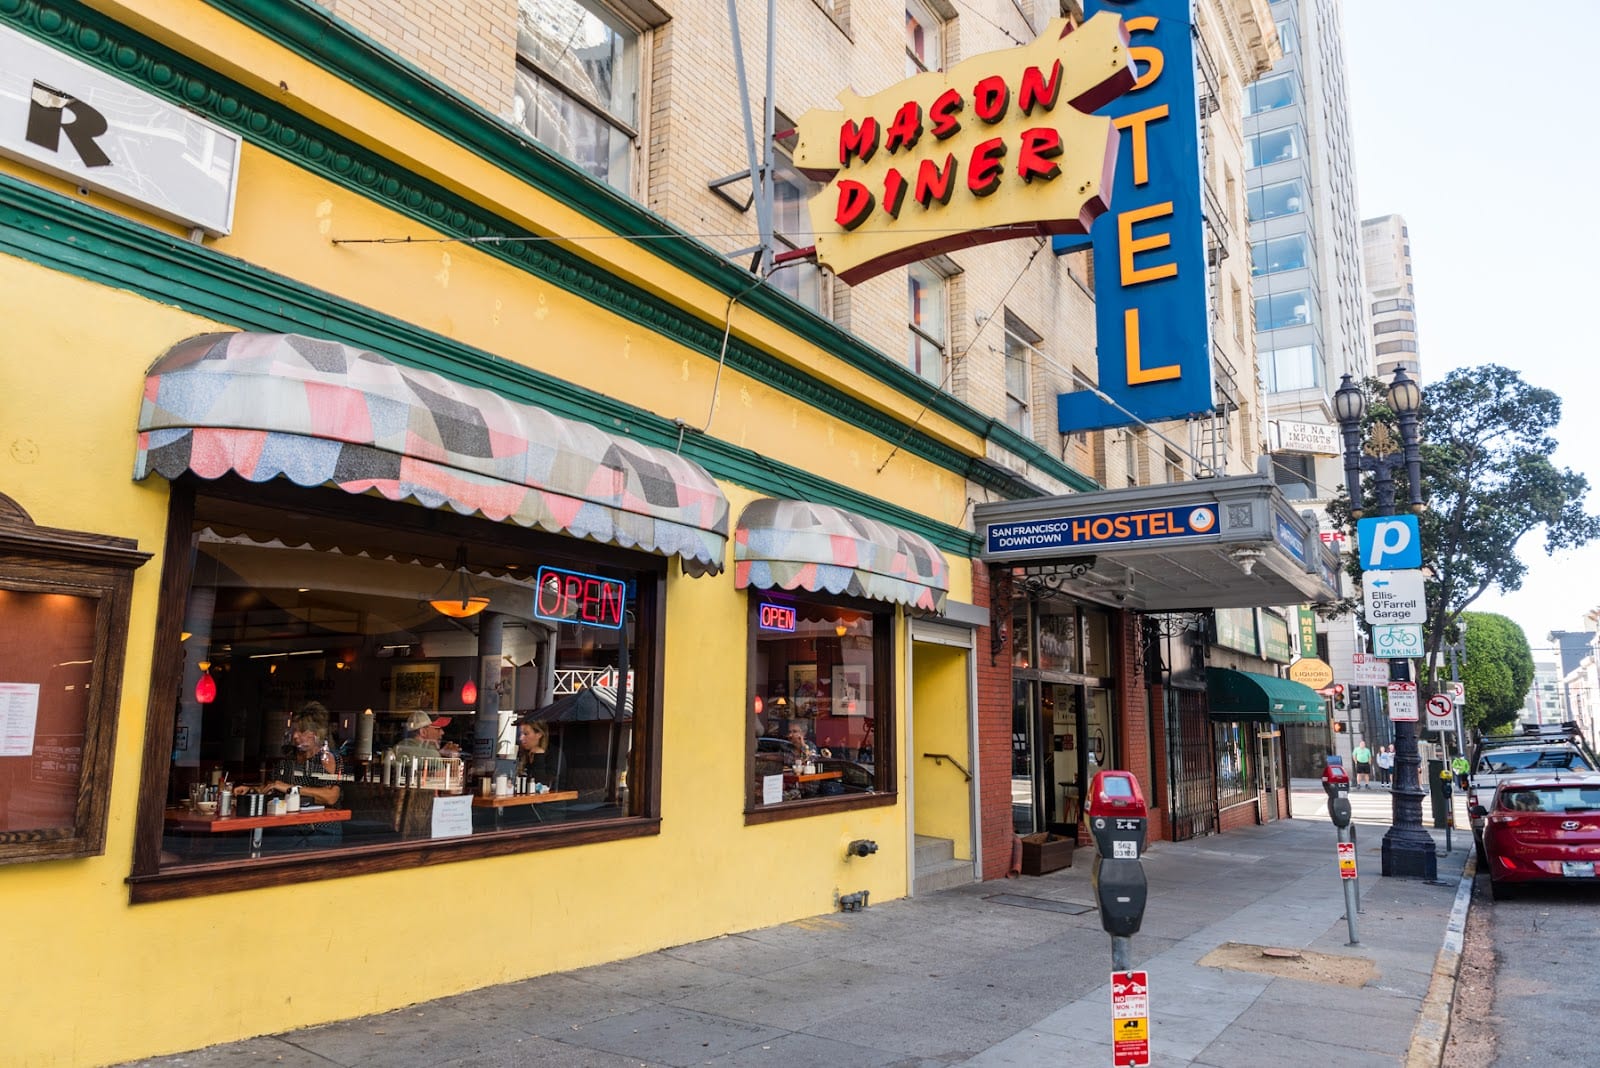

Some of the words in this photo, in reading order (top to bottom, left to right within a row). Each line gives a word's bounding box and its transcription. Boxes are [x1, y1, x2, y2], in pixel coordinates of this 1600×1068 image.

[838, 58, 1064, 168] MASON
[835, 127, 1064, 231] DINER
[1293, 424, 1325, 435] CHNA
[1289, 433, 1332, 445] IMPORTS
[992, 527, 1012, 538] SAN
[1013, 522, 1069, 536] FRANCISCO
[1072, 511, 1185, 542] HOSTEL
[999, 533, 1062, 548] DOWNTOWN
[538, 571, 623, 624] OPEN
[1372, 591, 1397, 600] Ellis-
[1372, 600, 1417, 609] O'Farrell
[762, 606, 795, 630] OPEN
[1372, 609, 1411, 620] Garage
[1301, 617, 1313, 652] MART
[1353, 654, 1364, 663] NO
[1429, 719, 1439, 727] ON
[1440, 719, 1453, 727] RED
